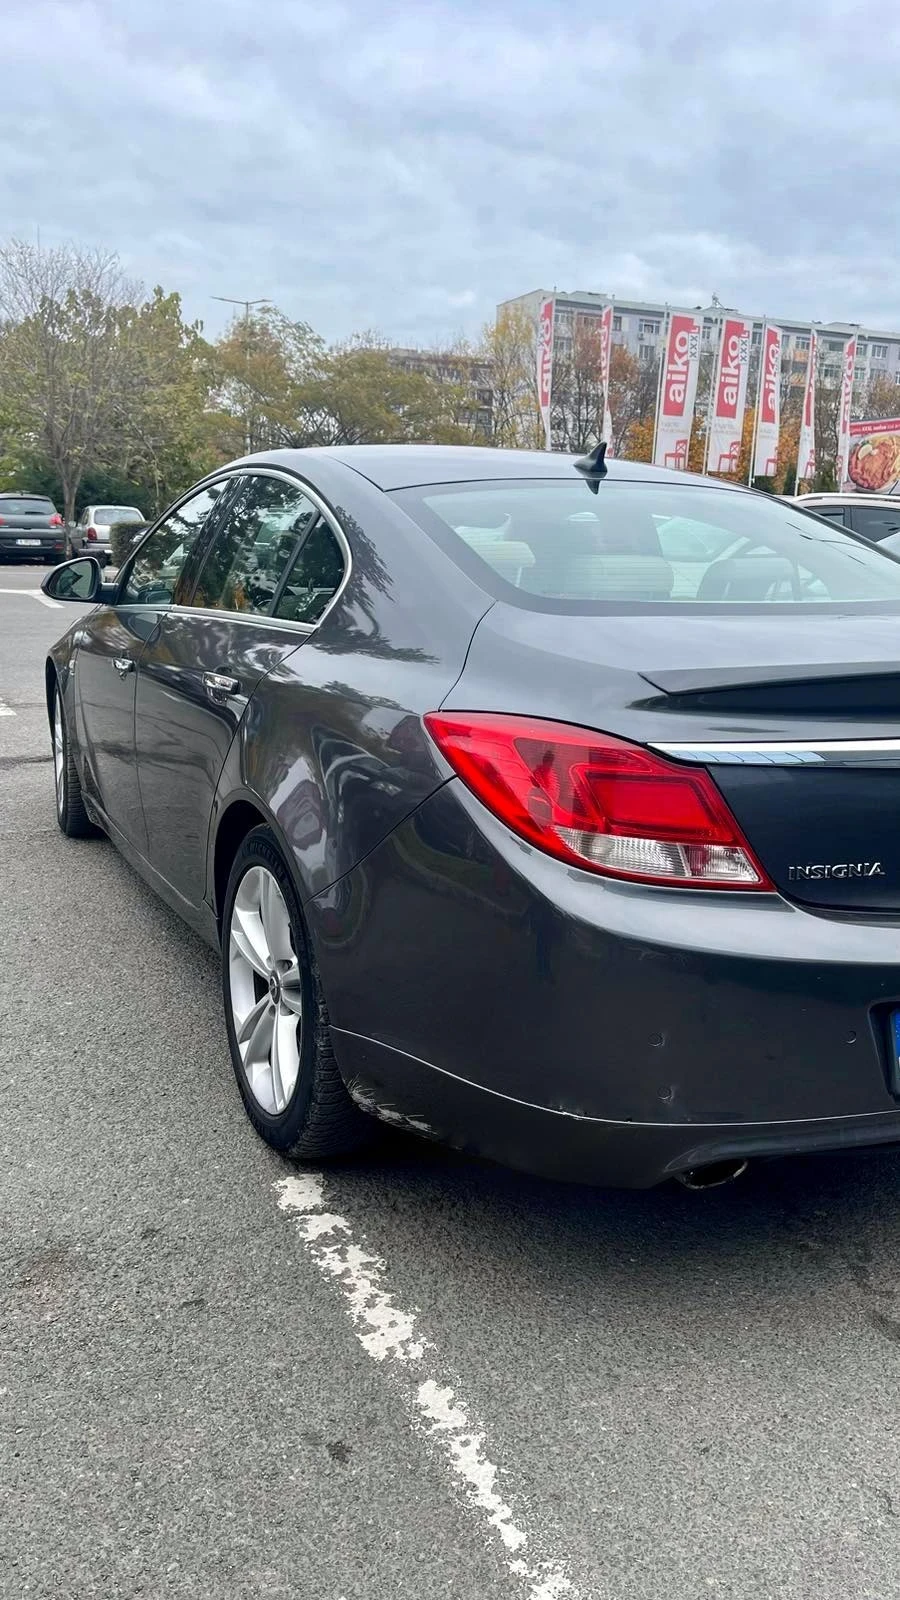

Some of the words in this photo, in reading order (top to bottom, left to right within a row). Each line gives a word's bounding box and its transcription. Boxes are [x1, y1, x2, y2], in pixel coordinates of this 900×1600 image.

[689, 325, 700, 358] XXXL
[740, 330, 749, 362] XXXL
[667, 331, 688, 403] aiko
[721, 335, 740, 406] aiko
[766, 343, 779, 411] aiko
[788, 862, 885, 880] INSIGNIA
